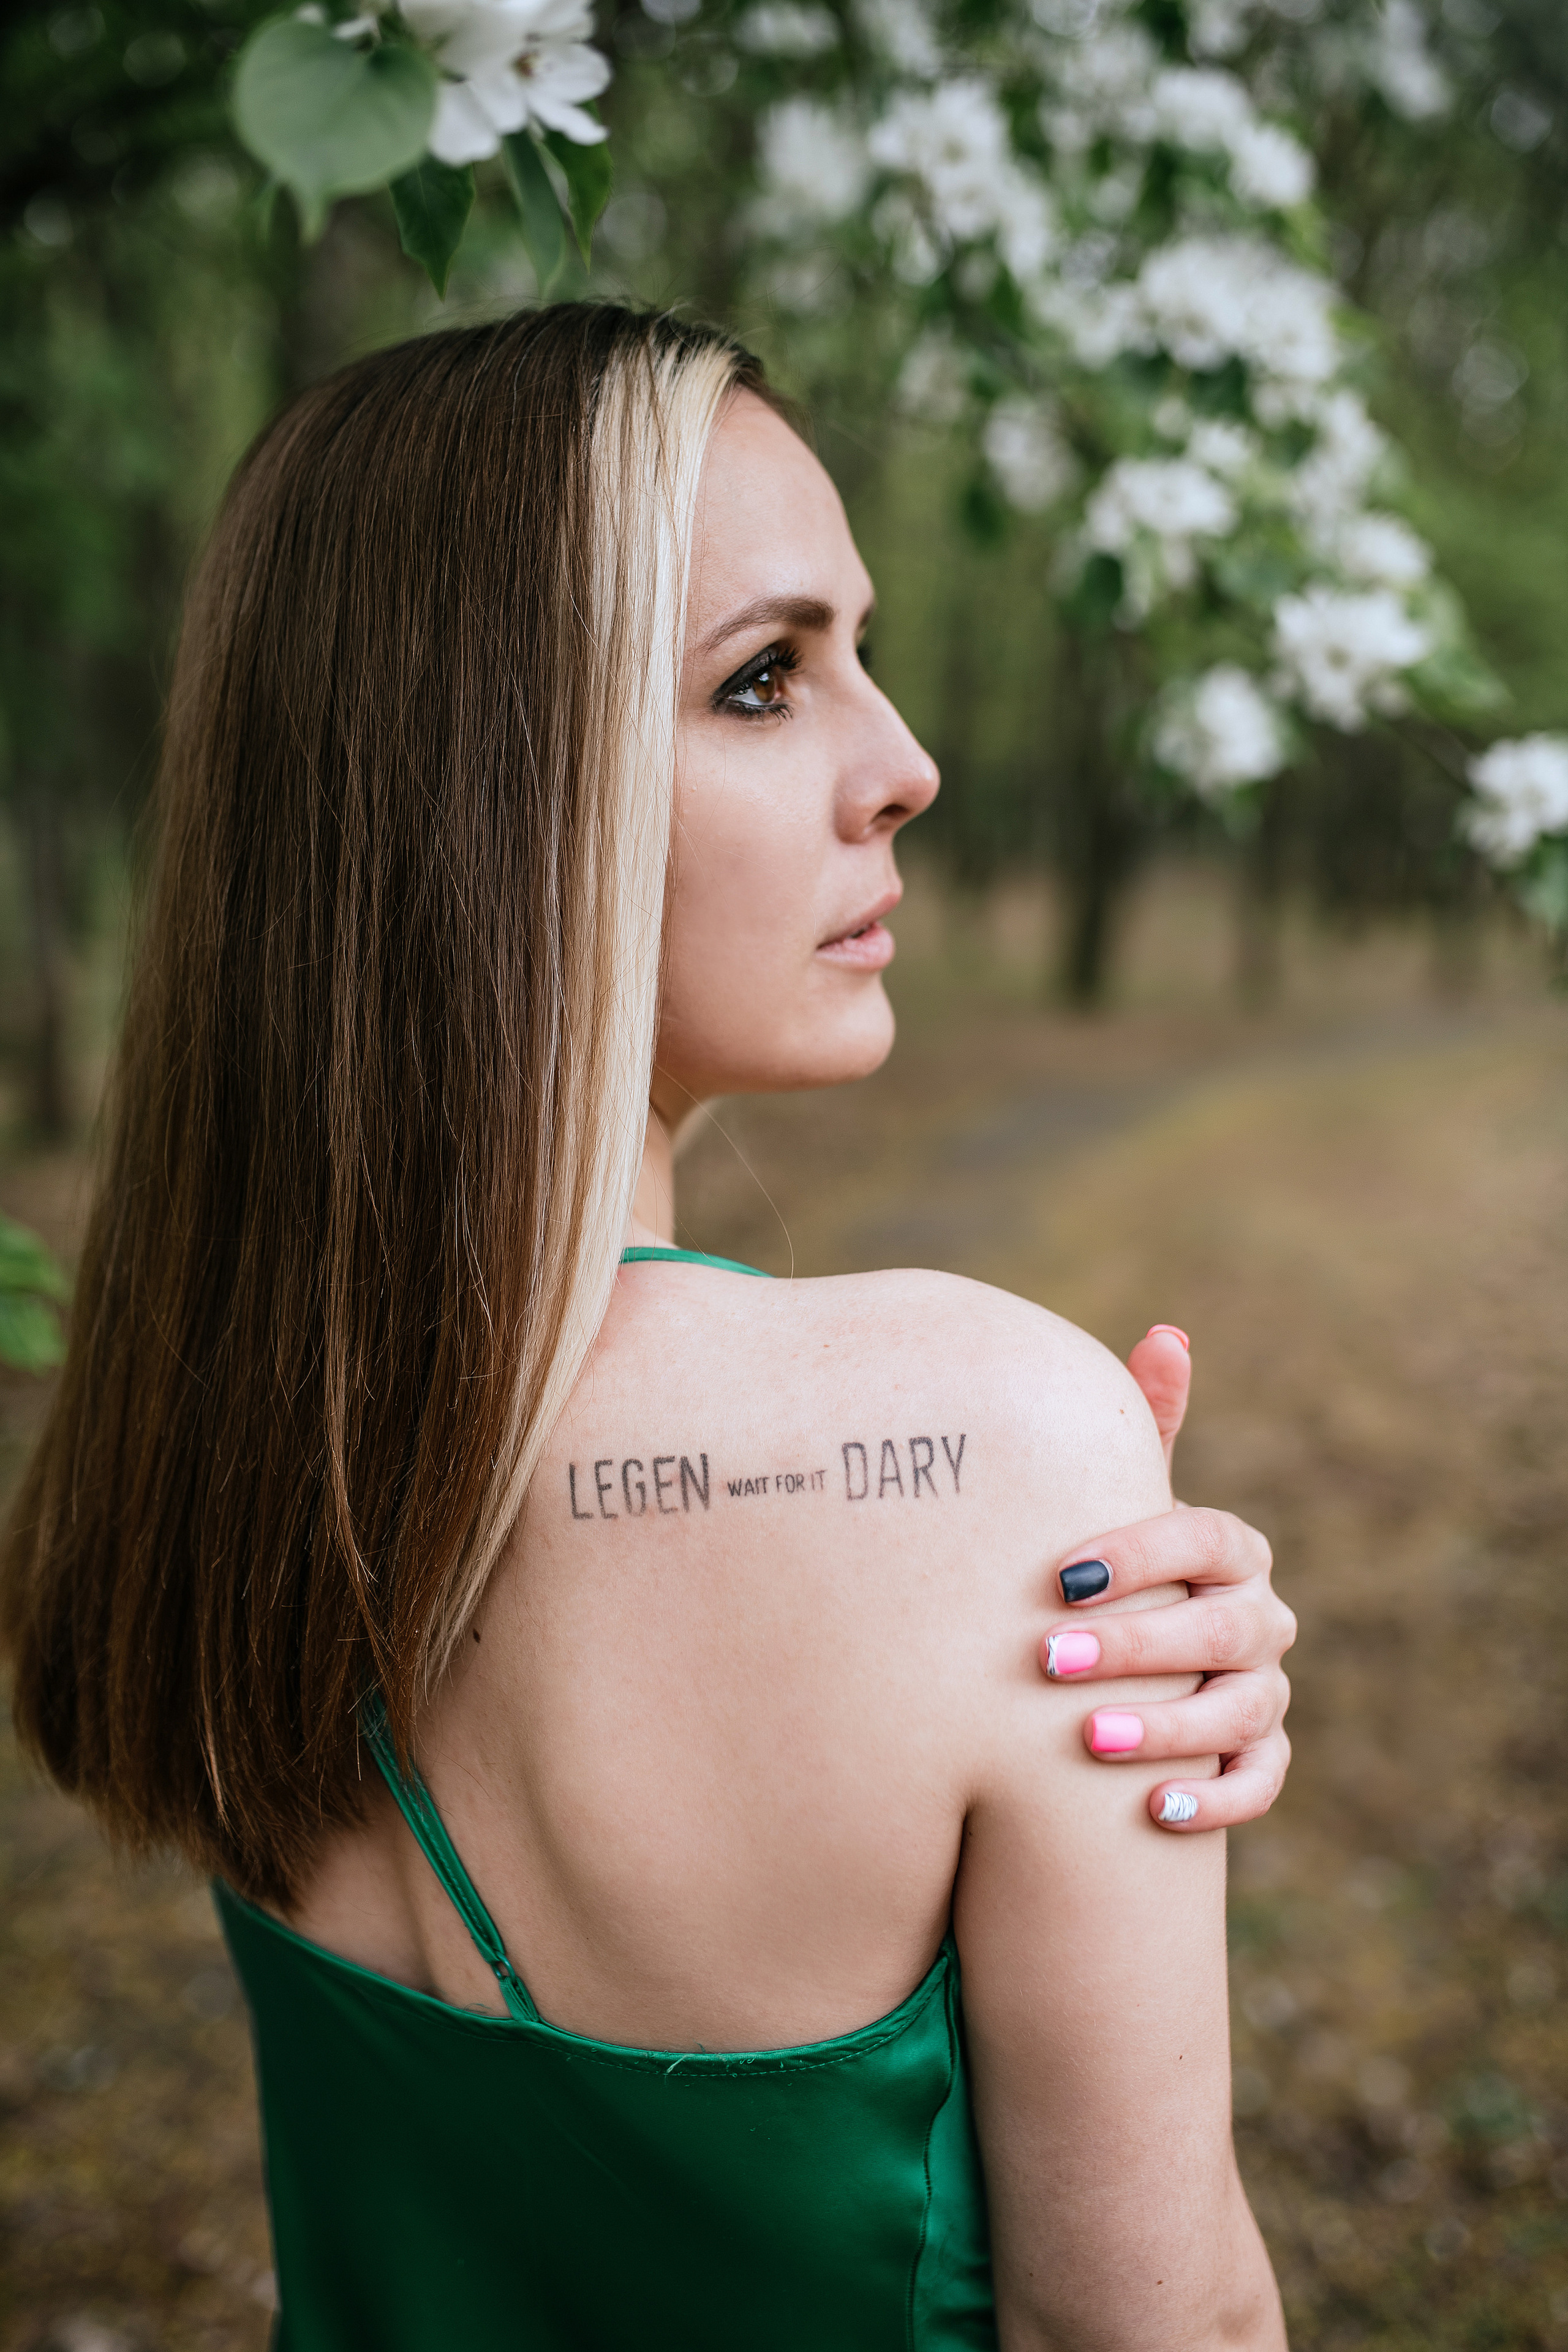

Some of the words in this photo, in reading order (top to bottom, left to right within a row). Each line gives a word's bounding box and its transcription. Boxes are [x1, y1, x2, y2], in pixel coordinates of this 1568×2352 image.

[569, 1453, 710, 1520] LEGEN
[727, 1477, 769, 1496] WAIT
[775, 1474, 805, 1493] FOR
[810, 1469, 827, 1490] IT
[842, 1433, 967, 1501] DARY
